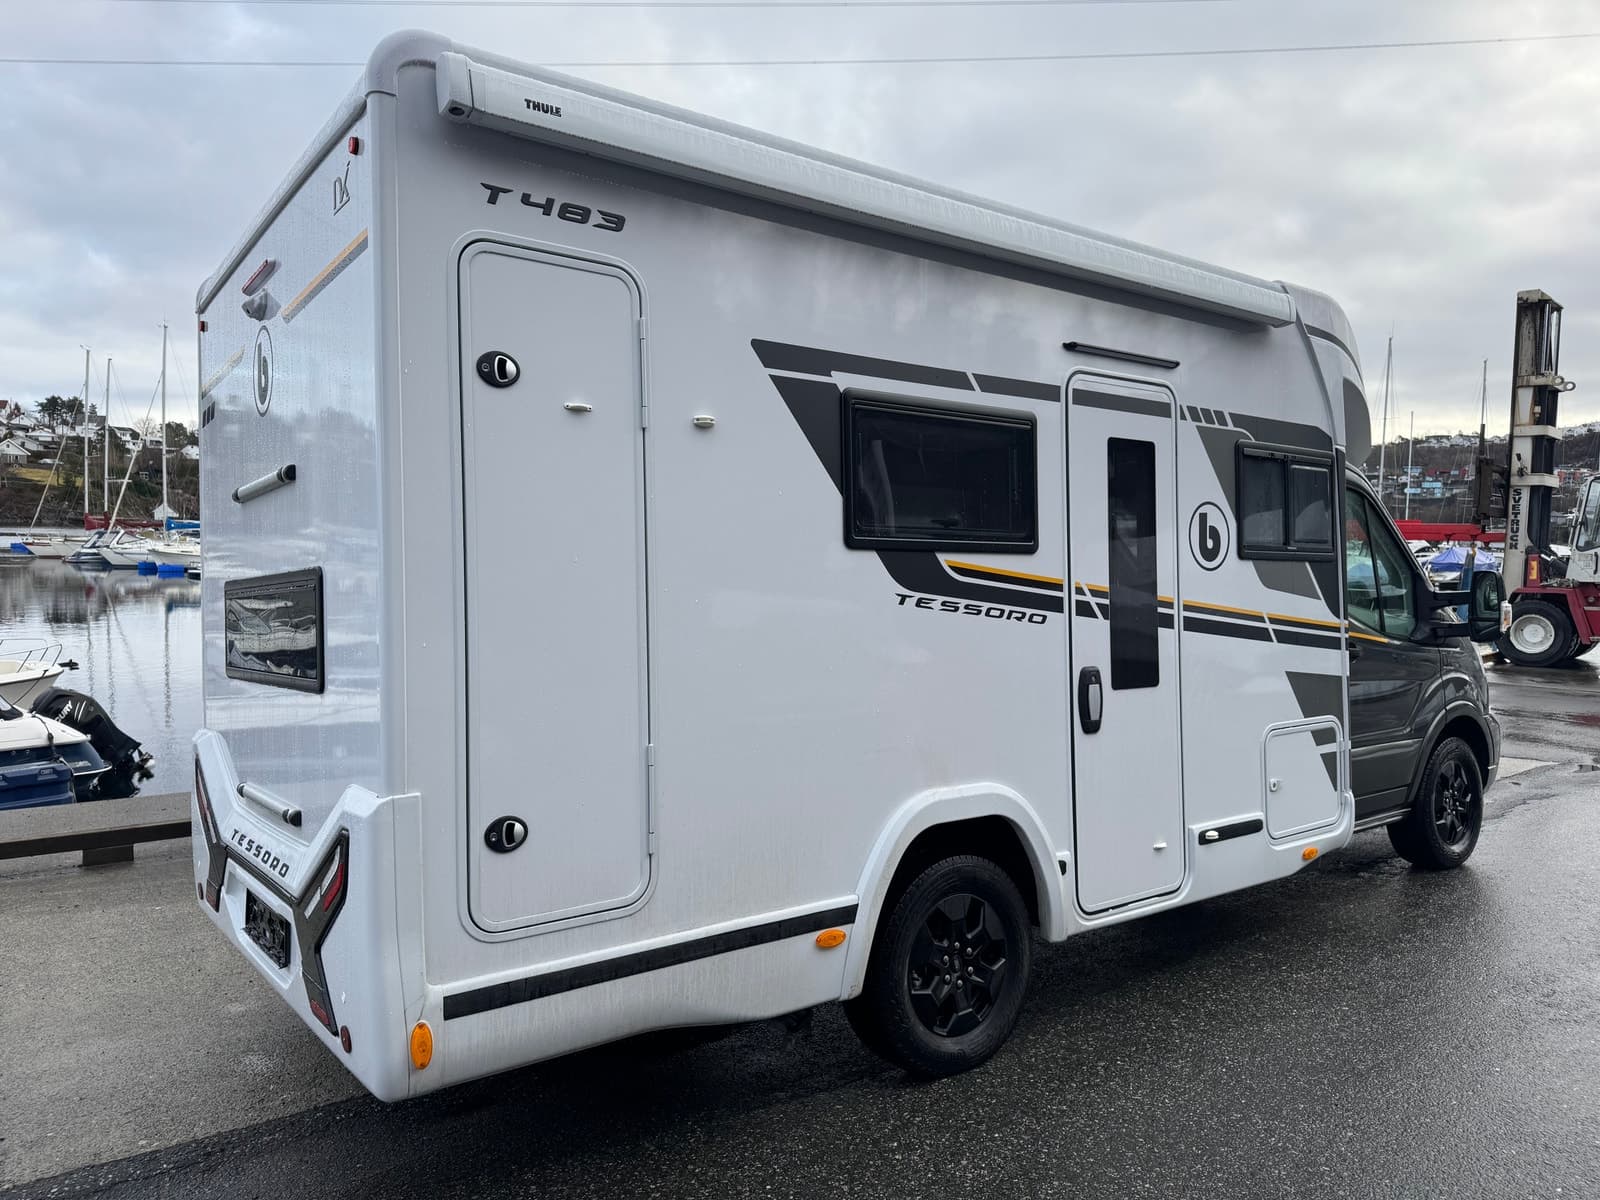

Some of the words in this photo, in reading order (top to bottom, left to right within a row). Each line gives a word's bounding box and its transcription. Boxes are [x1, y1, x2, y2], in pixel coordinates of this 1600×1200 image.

[524, 98, 562, 118] THULE
[1509, 488, 1522, 550] SVETRUCK
[895, 592, 1048, 625] TESSORO
[231, 828, 290, 878] TESSORO
